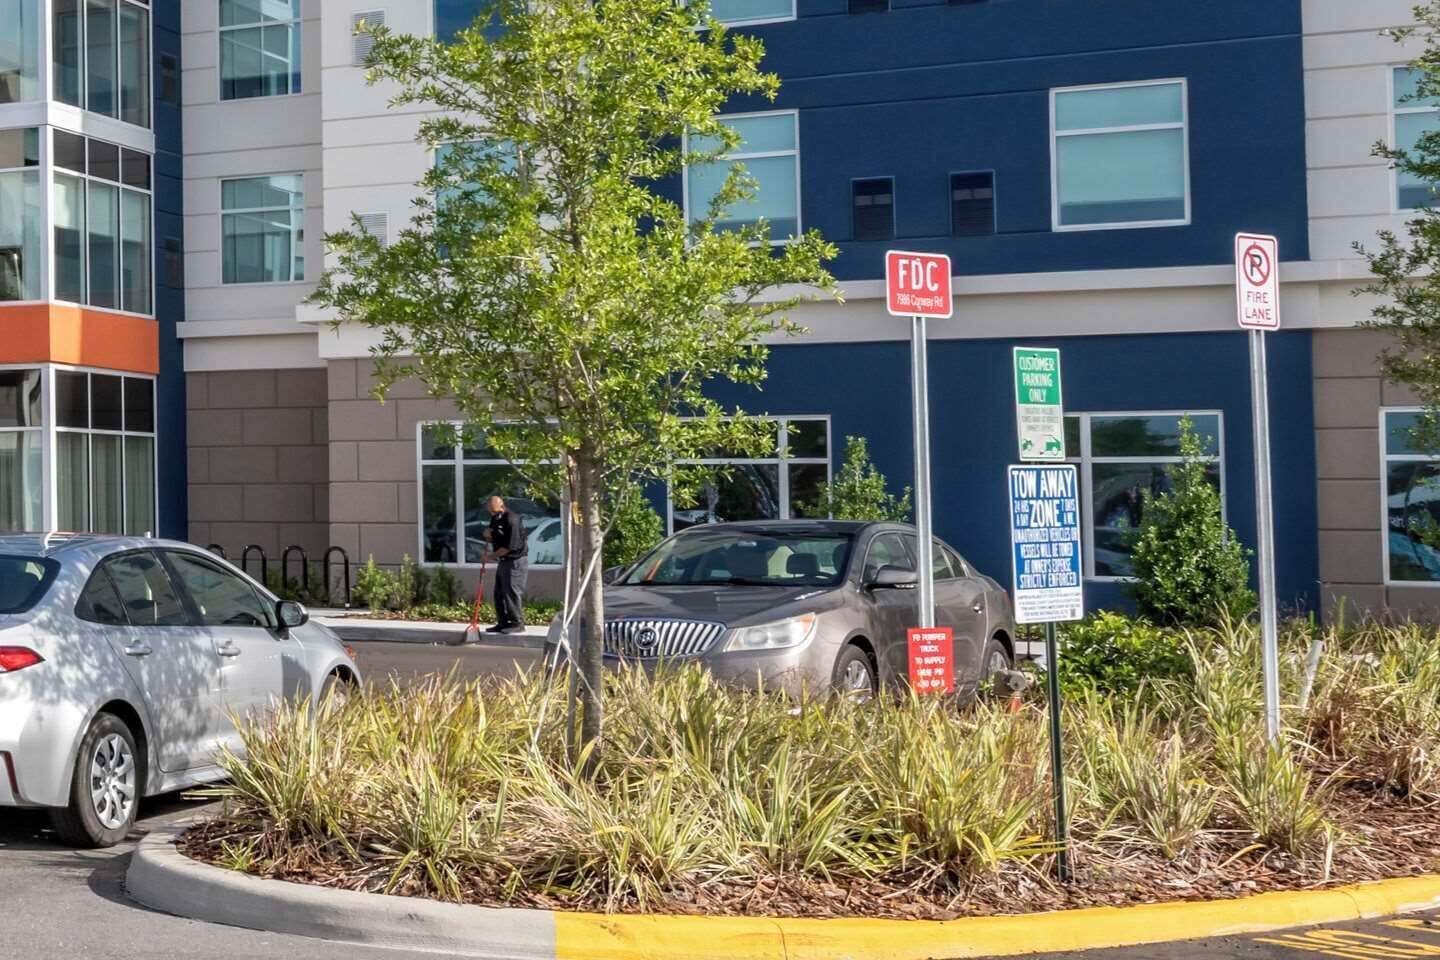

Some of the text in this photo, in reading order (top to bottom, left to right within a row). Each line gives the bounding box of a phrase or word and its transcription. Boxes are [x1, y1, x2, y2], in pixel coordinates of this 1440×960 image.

[898, 258, 939, 292] FDC
[1247, 290, 1269, 304] FIRE
[1245, 308, 1272, 321] LANE
[1019, 357, 1055, 371] CUSTOMER
[1022, 372, 1053, 388] PARKING
[1028, 388, 1047, 402] ONLY
[1012, 470, 1073, 498] TOW AWAY
[1064, 499, 1076, 512] DAYS
[1020, 513, 1029, 527] DAY
[1029, 499, 1062, 527] ZONE
[1049, 527, 1070, 542] VEHICLES
[1020, 542, 1073, 558] VESSELS WILL BE TOWED
[1024, 559, 1030, 573] AT
[1051, 557, 1072, 572] EXPENSE
[1020, 571, 1077, 589] STRICTLY ENFORCED
[920, 644, 940, 653] TRUCK
[914, 656, 946, 664] TO SUPPLY
